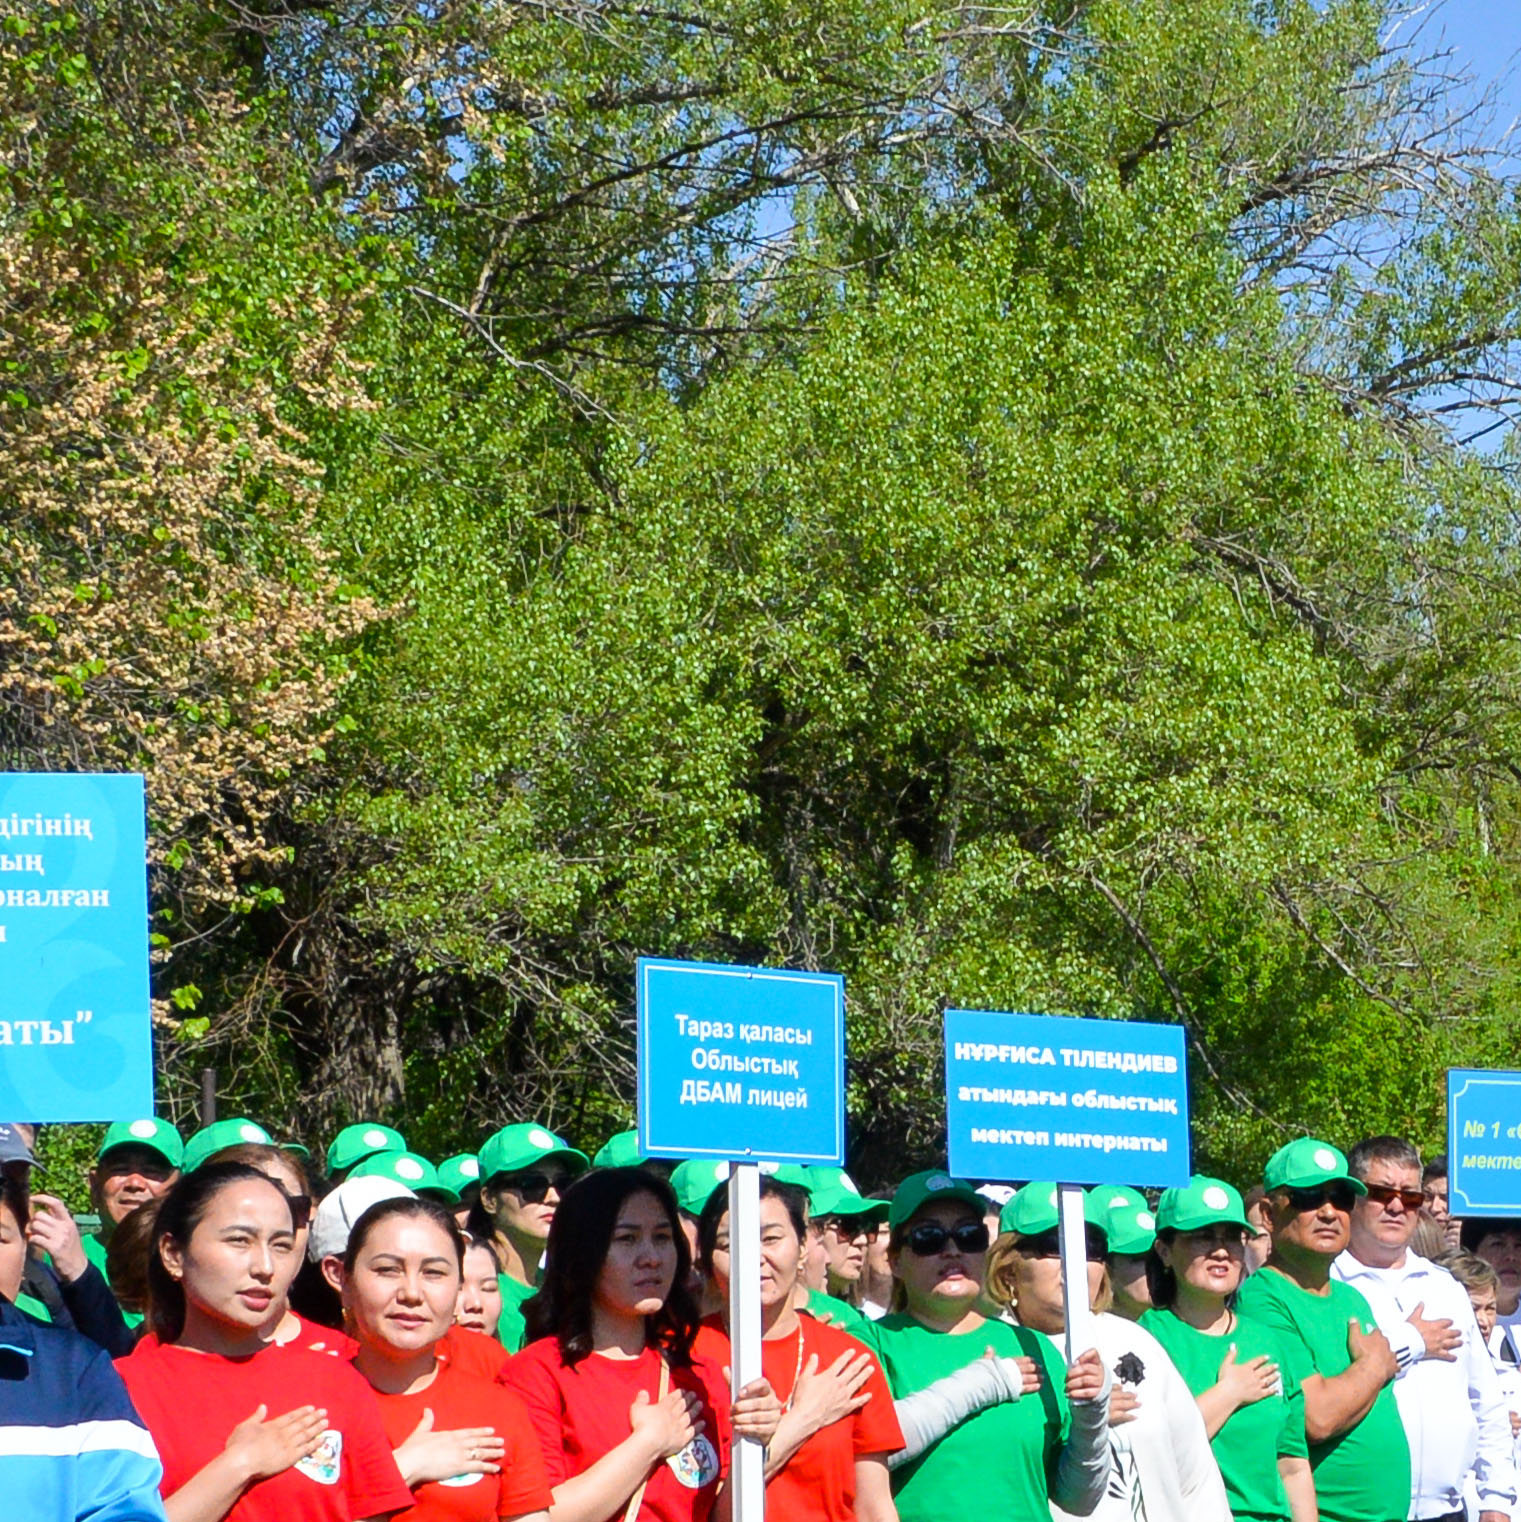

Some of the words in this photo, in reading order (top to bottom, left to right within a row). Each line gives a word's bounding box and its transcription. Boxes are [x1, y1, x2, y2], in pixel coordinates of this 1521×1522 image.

[674, 1013, 734, 1042] Тараз
[739, 1023, 812, 1045] қаласы
[691, 1048, 799, 1079] Облыстық
[1060, 1048, 1178, 1073] ТІЛЕНДИЕВ
[680, 1079, 742, 1105] ДБАМ
[747, 1087, 808, 1110] лицей
[958, 1086, 1067, 1106] атындағы
[1072, 1089, 1178, 1115] облыстық
[971, 1128, 1050, 1146] мектеп
[1055, 1132, 1168, 1153] интернаты
[1491, 1120, 1501, 1138] 1
